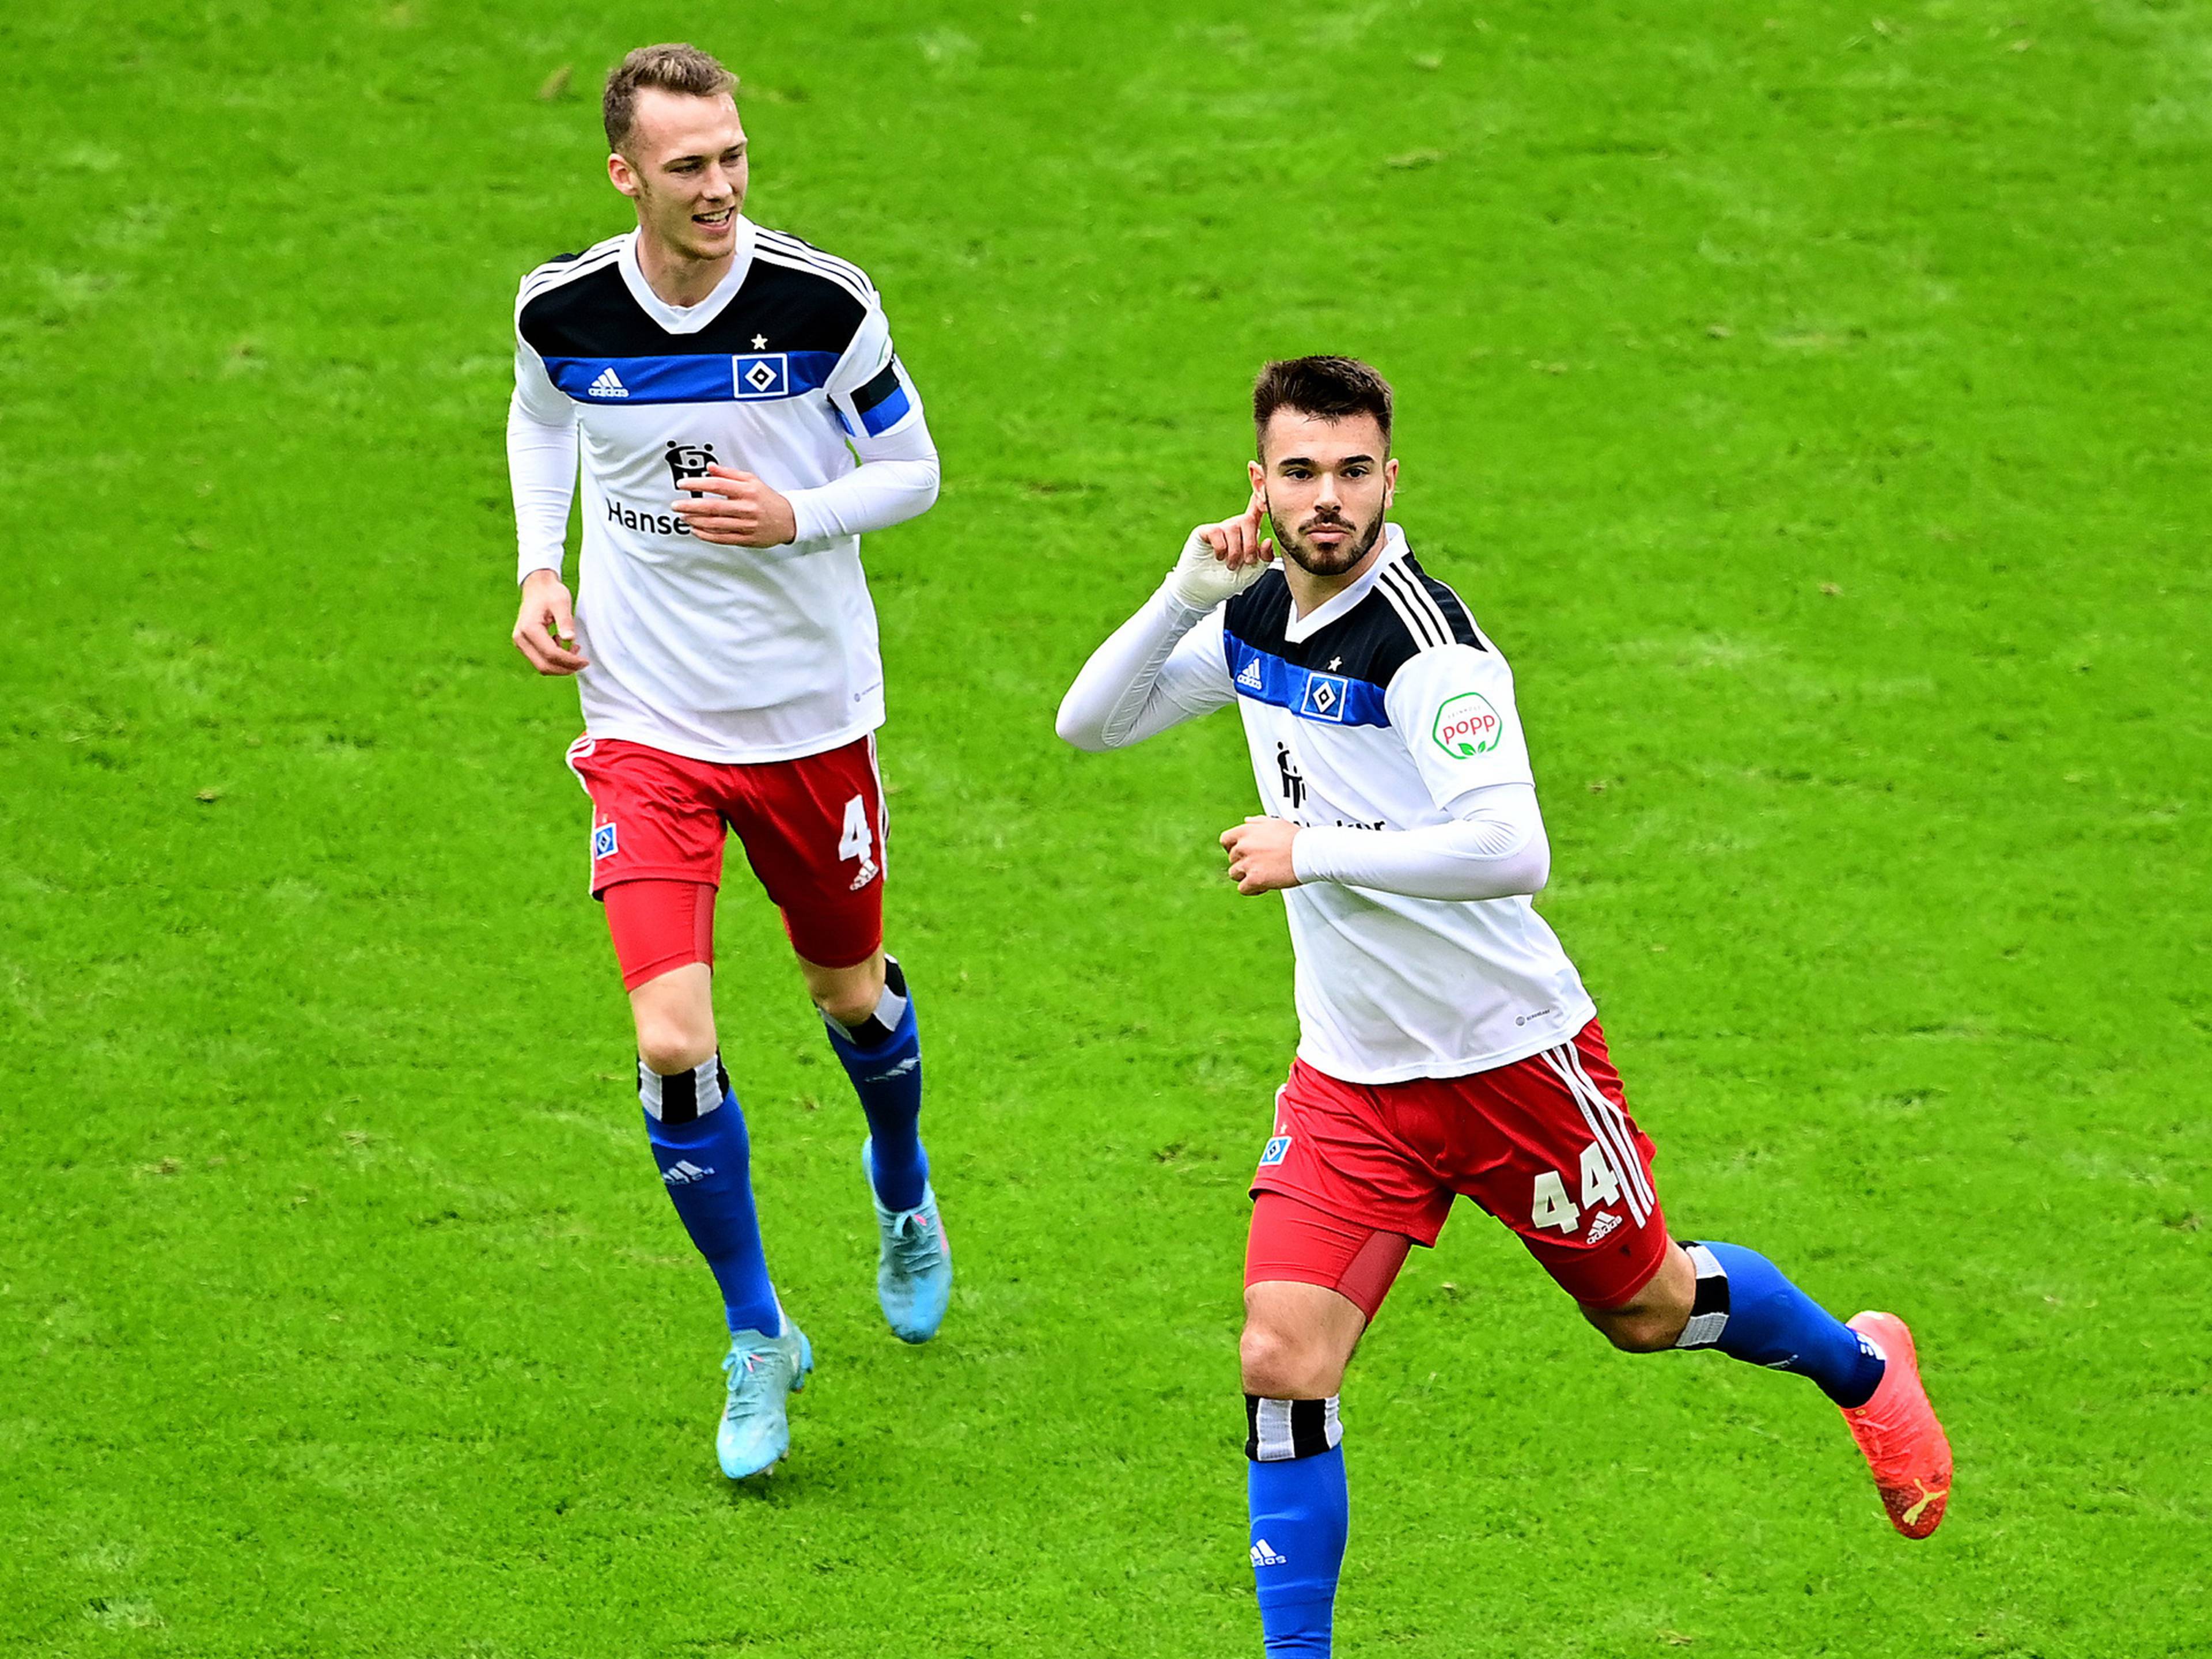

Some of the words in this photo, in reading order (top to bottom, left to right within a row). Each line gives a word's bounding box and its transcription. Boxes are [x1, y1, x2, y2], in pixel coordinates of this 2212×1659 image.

[588, 387, 629, 397] adidas
[1443, 715, 1495, 745] popp
[838, 794, 873, 863] 4
[1532, 1140, 1620, 1234] 44
[1586, 1215, 1623, 1244] adidas
